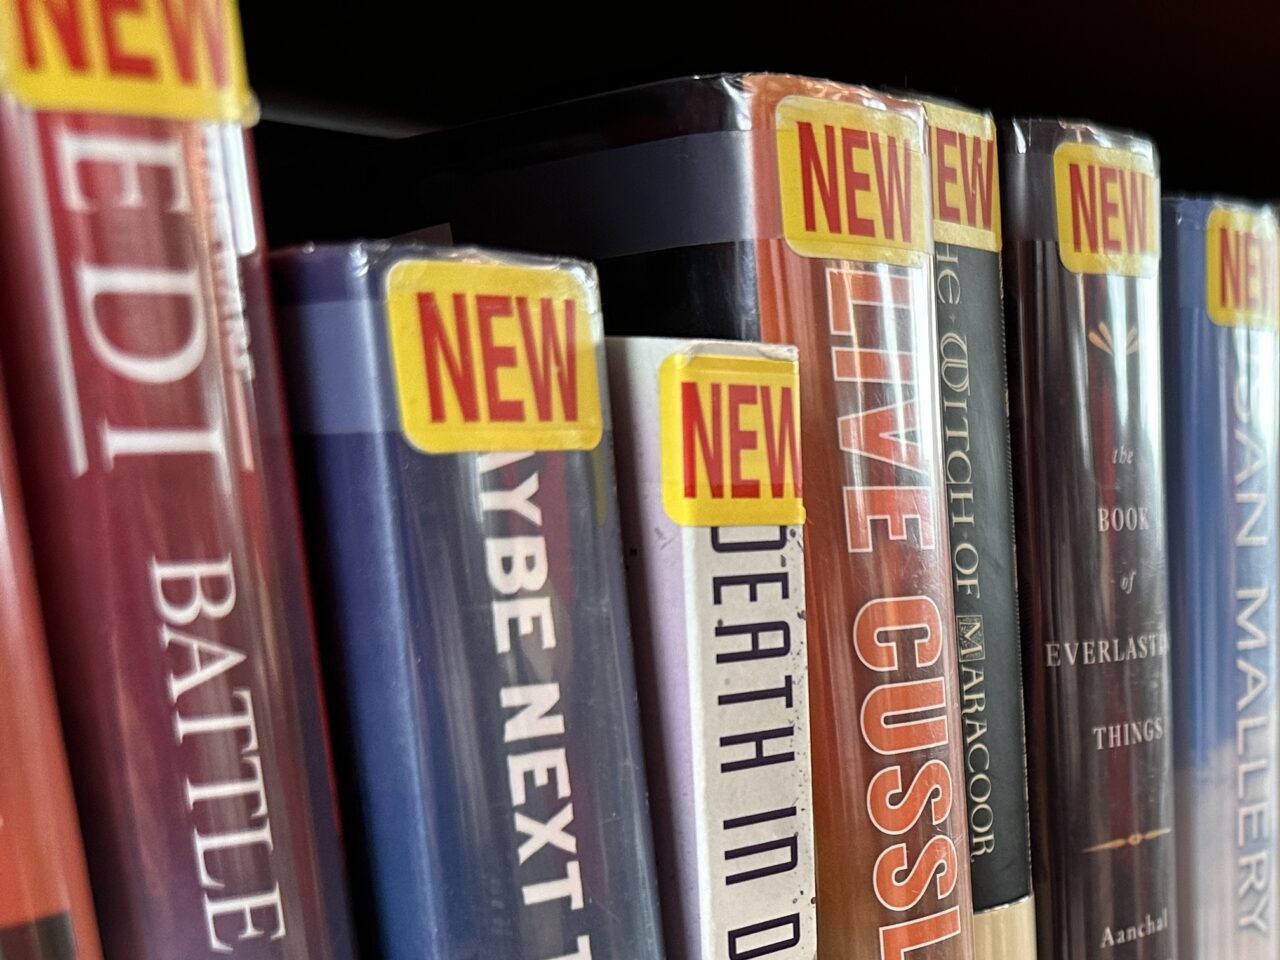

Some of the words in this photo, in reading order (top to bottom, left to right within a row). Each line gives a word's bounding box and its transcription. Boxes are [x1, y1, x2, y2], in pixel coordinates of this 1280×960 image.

[796, 121, 912, 243] NEW
[1069, 162, 1149, 254] NEW
[416, 291, 580, 424] NEW
[681, 382, 799, 500] NEW
[940, 332, 976, 528] WITCH
[1111, 445, 1135, 467] the
[954, 542, 980, 600] OF
[1098, 505, 1152, 533] BOOK
[1120, 568, 1138, 594] of
[149, 553, 286, 954] BATTLE
[955, 612, 997, 867] MARACOOR
[1093, 716, 1164, 751] THINGS
[1235, 587, 1271, 938] MALLERY
[500, 681, 585, 913] NEXT
[1100, 907, 1169, 949] Aanchal
